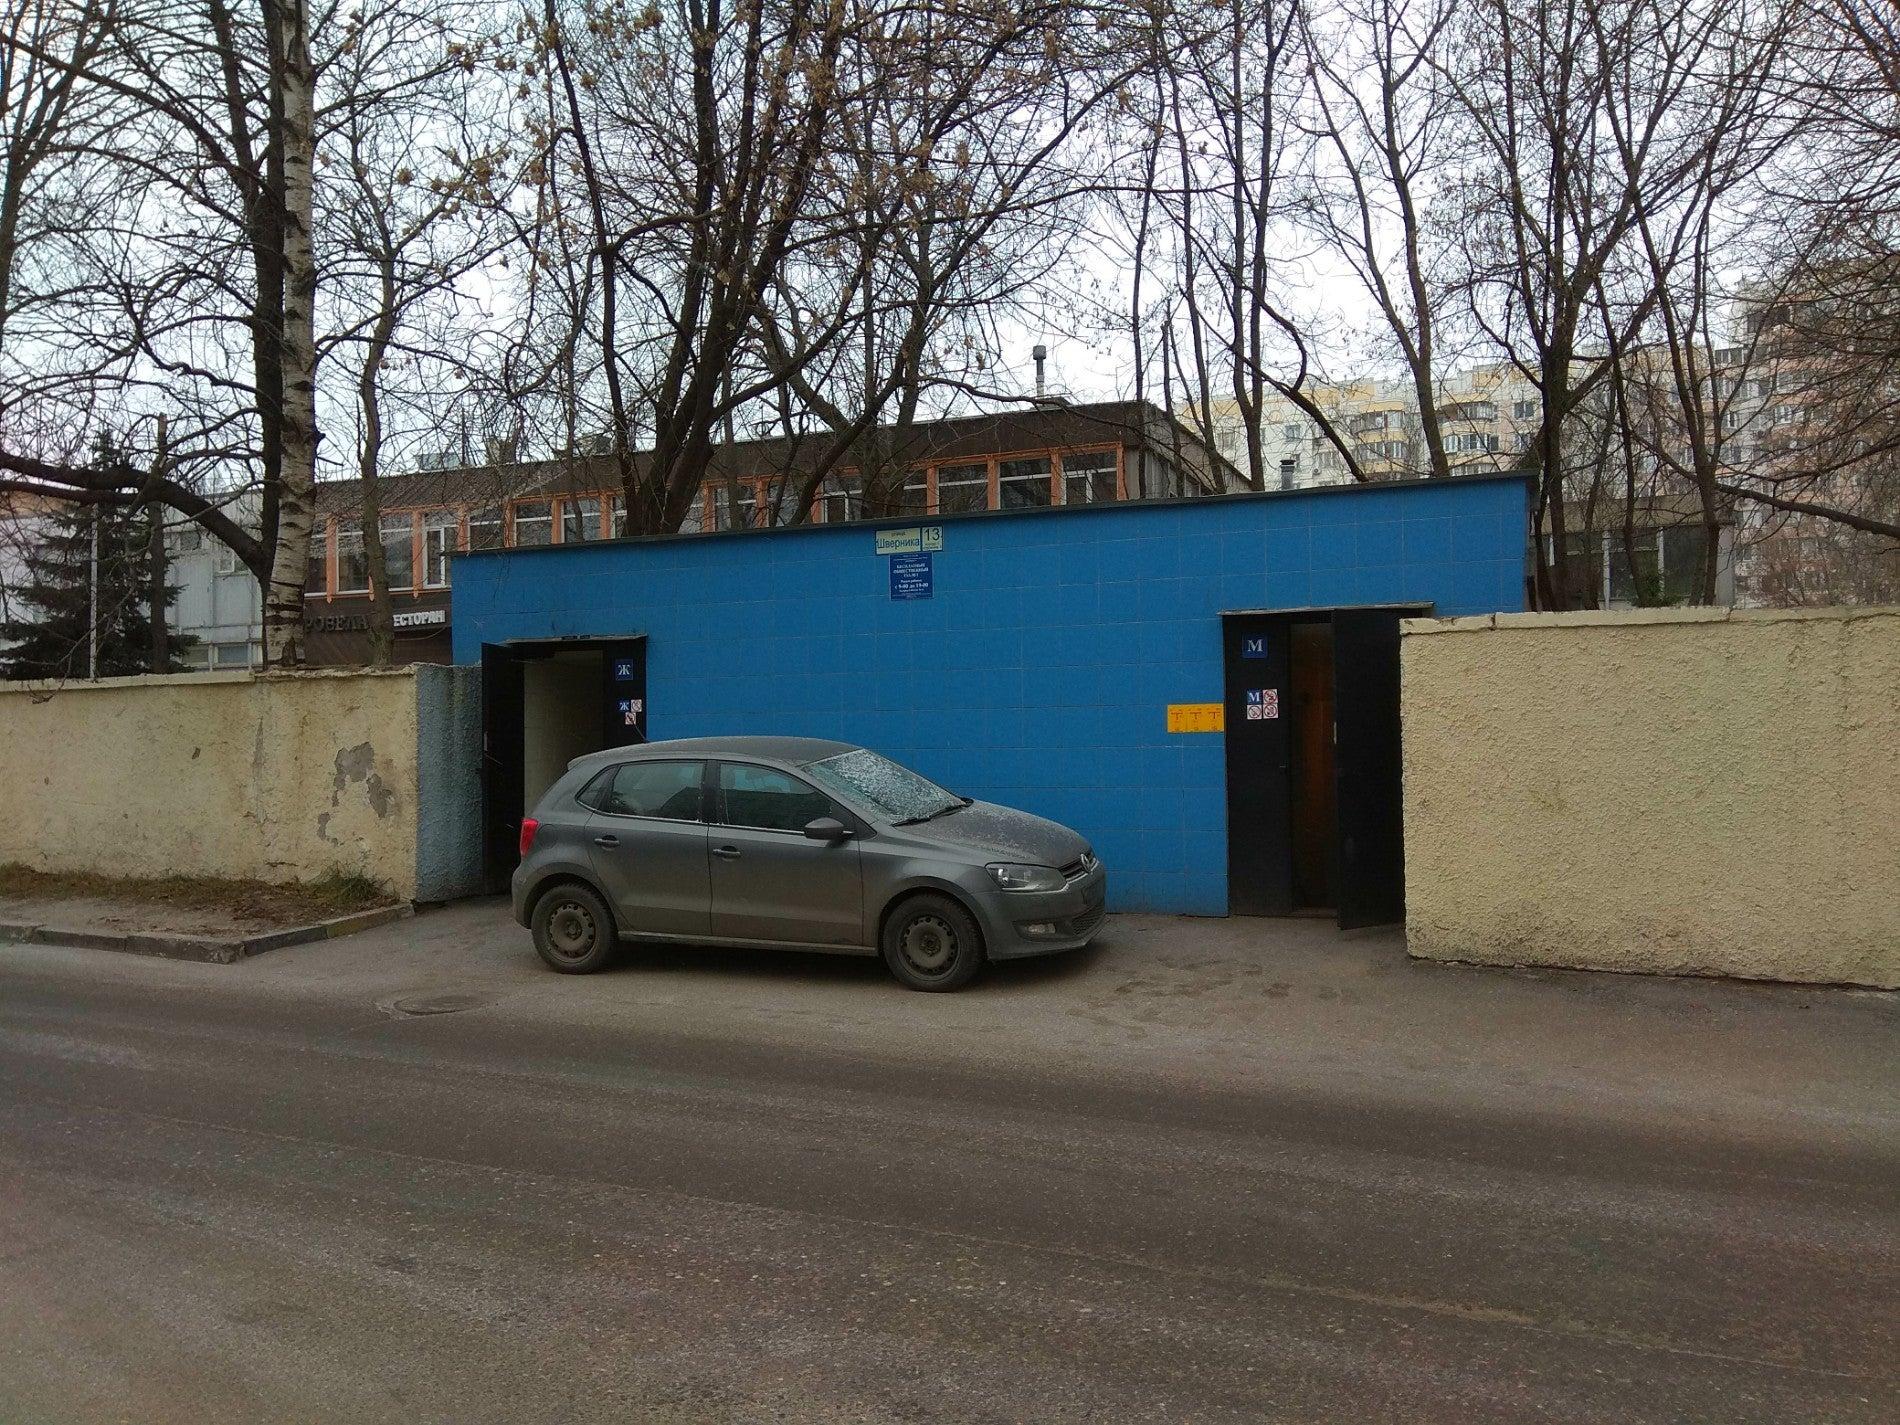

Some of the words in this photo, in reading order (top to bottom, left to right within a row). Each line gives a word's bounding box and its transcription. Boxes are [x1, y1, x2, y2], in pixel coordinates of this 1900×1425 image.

[924, 527, 940, 541] 13
[877, 538, 920, 550] Шверника
[392, 610, 446, 627] ЕСТОРАН
[1247, 639, 1263, 652] М
[618, 664, 630, 675] Ж
[619, 702, 629, 710] Ж
